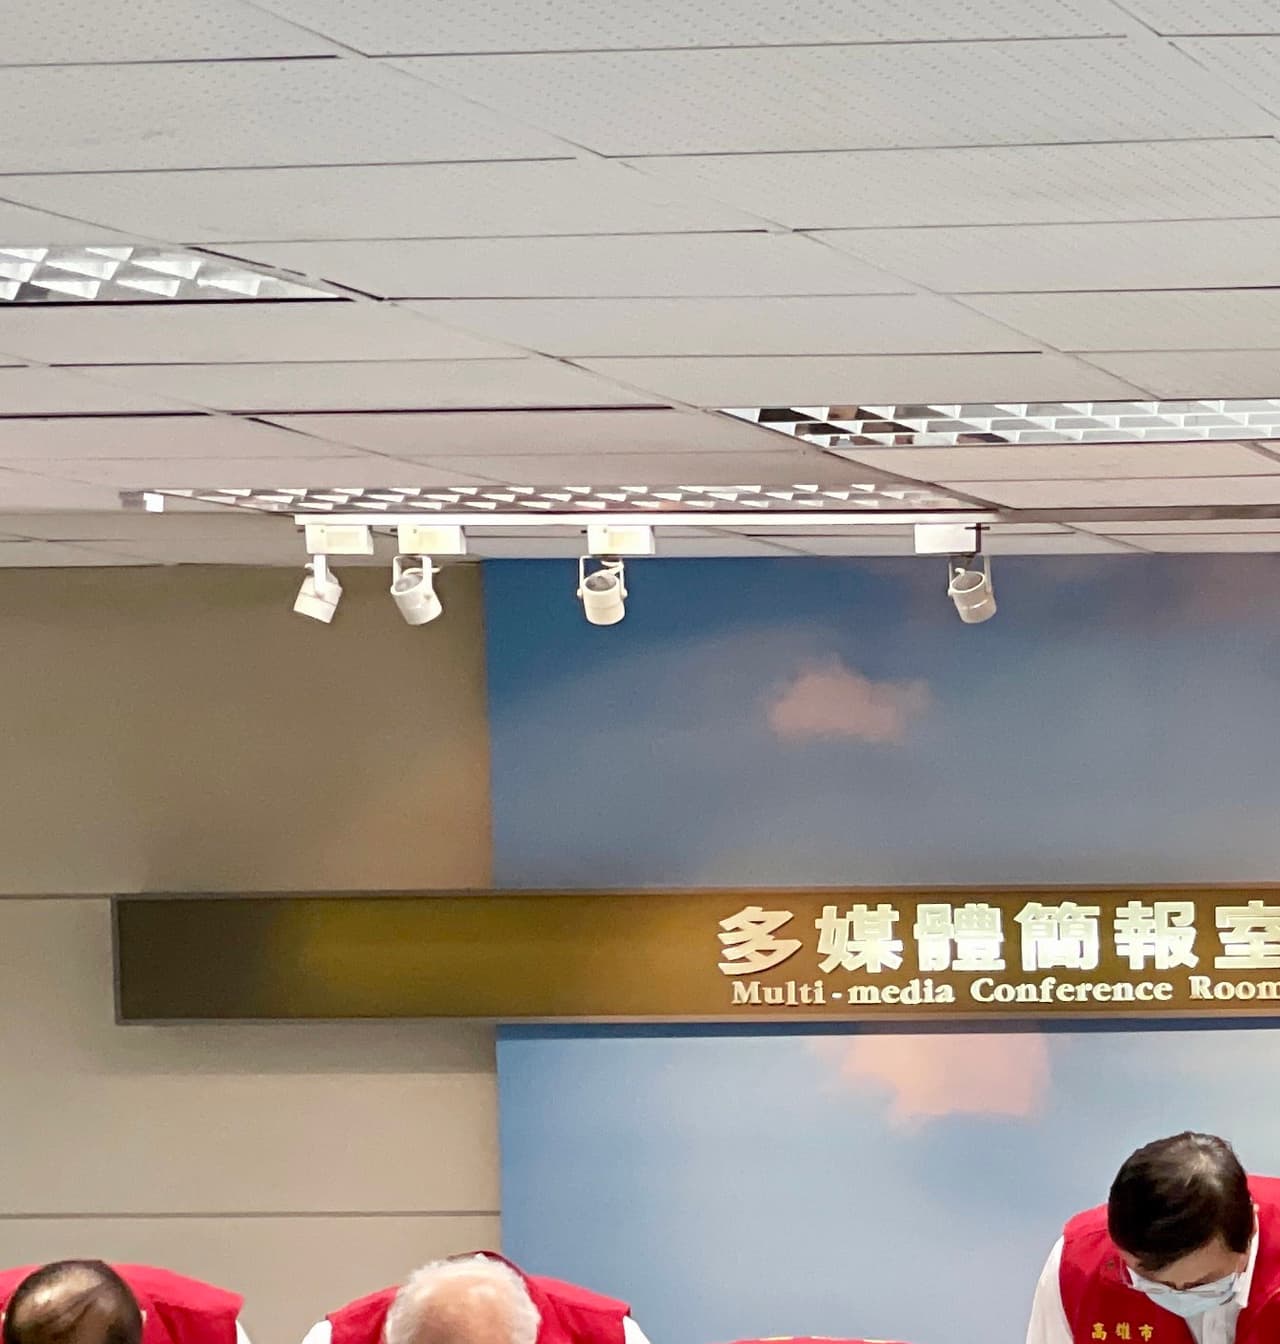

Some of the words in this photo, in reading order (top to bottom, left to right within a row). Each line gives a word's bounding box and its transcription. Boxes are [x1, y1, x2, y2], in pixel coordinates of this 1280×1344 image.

[970, 976, 1173, 1004] Conference
[1091, 1321, 1154, 1343] 高雄市
